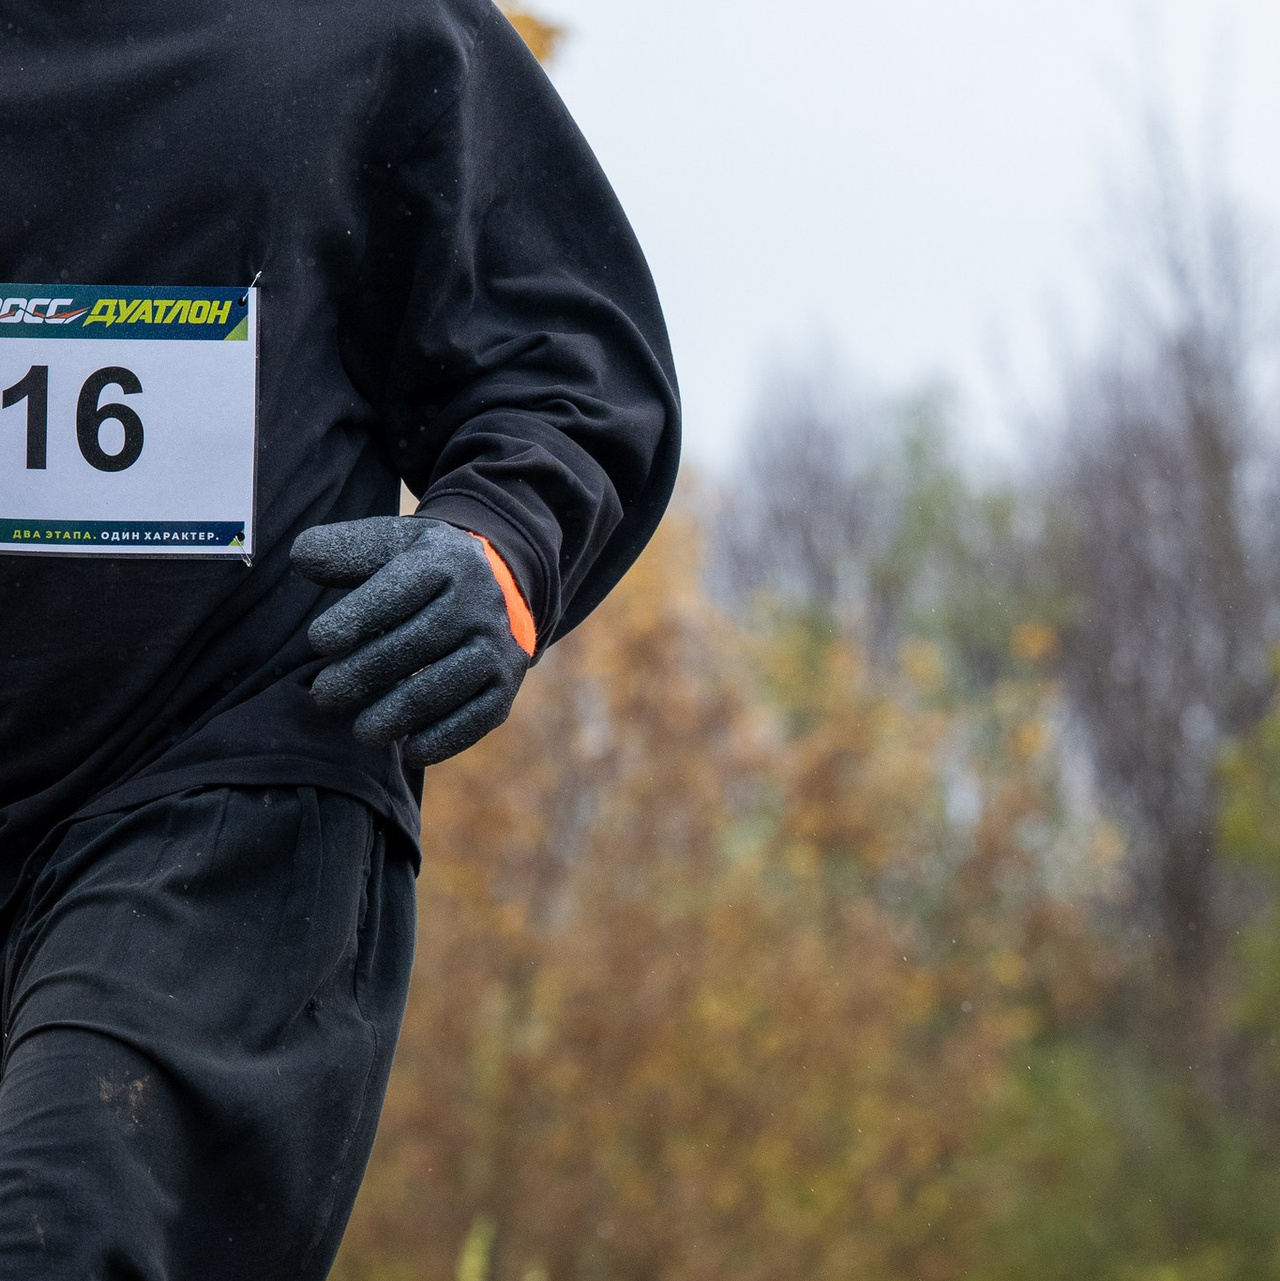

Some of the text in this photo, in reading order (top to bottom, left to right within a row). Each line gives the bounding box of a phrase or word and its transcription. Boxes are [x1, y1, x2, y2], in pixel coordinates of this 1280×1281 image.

[82, 299, 233, 328] ДУАТЛОН
[1, 365, 144, 472] 16
[12, 529, 220, 542] ДВА ЭТАПА. ОДИН ХАРАКТЕР.
